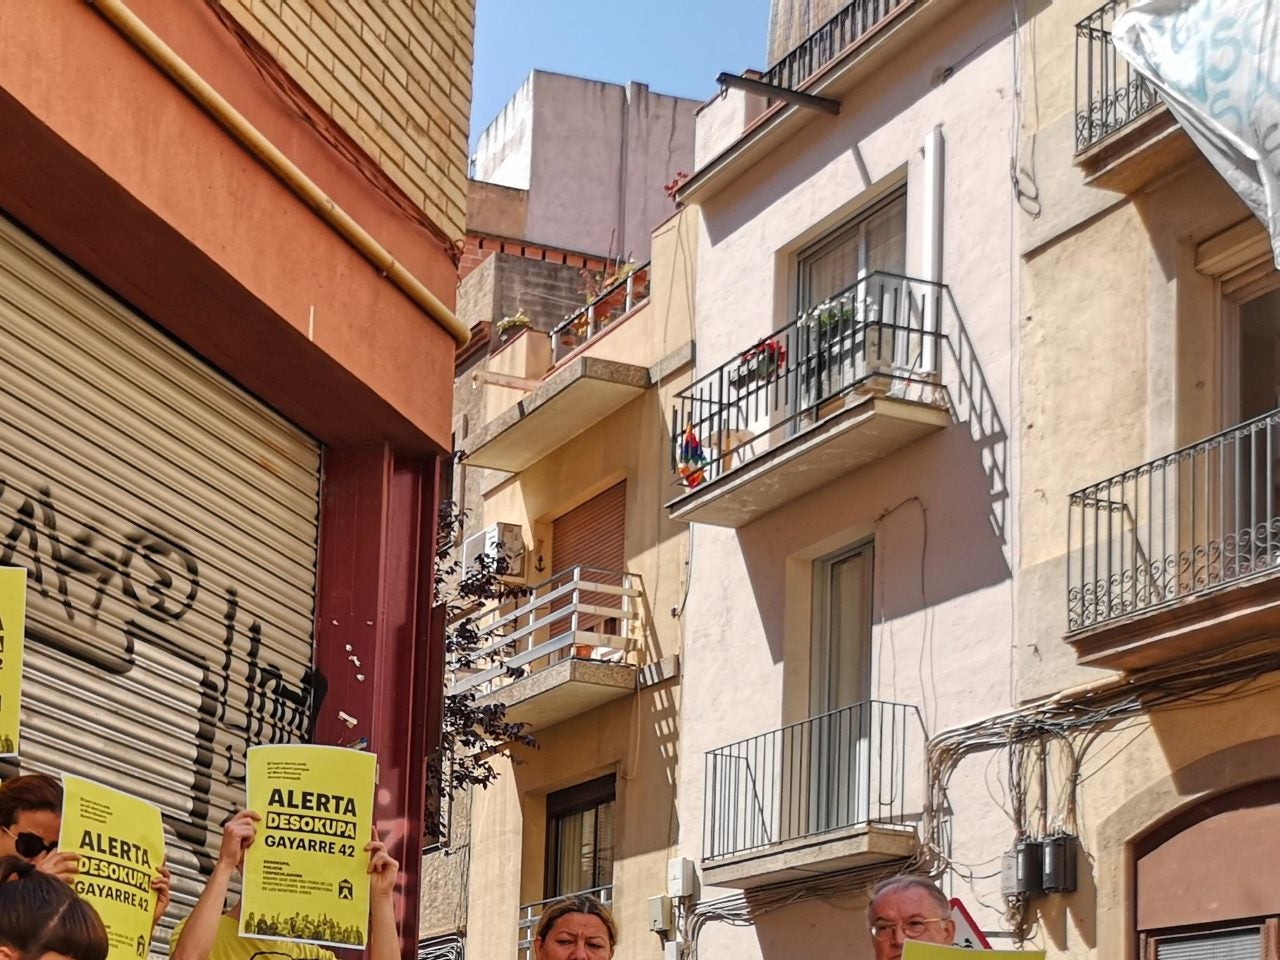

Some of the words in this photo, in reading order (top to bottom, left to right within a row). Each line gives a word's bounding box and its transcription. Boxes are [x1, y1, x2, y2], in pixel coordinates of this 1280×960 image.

[268, 788, 357, 817] ALERTA
[266, 813, 355, 838] DESOKUPA
[80, 830, 151, 869] ALERTA
[264, 835, 335, 854] GAYARRE
[338, 844, 355, 857] 42
[78, 858, 150, 892] DESOKUPA
[75, 881, 136, 907] GAYARRE
[138, 895, 149, 912] 42
